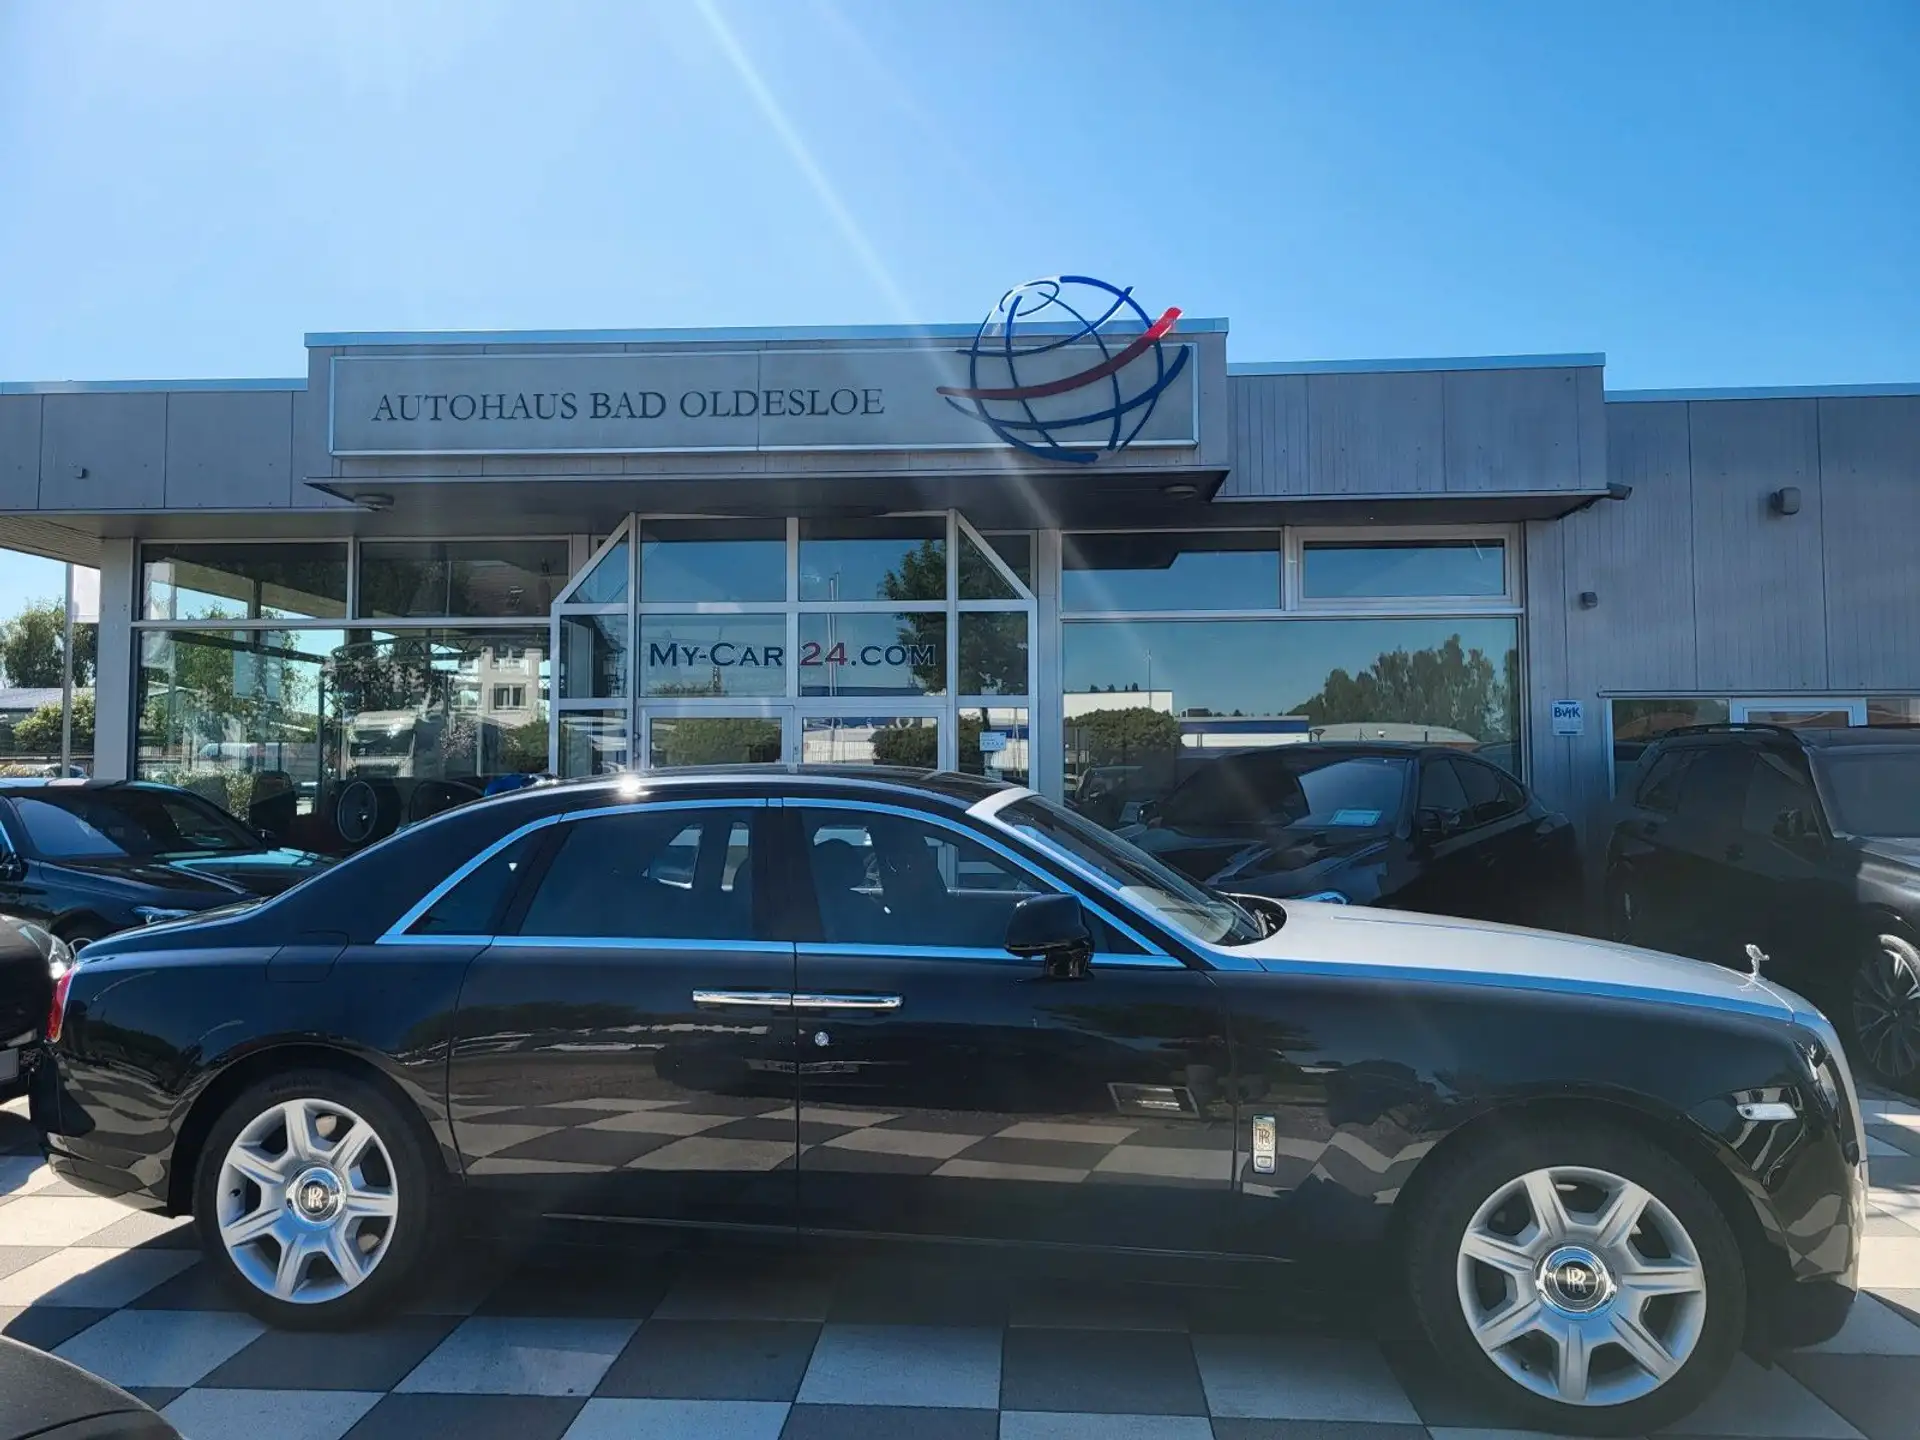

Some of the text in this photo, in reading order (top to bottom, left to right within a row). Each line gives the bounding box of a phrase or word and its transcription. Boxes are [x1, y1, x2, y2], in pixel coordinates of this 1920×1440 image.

[371, 388, 885, 421] AUTOHAUS BAD OLDESLOE
